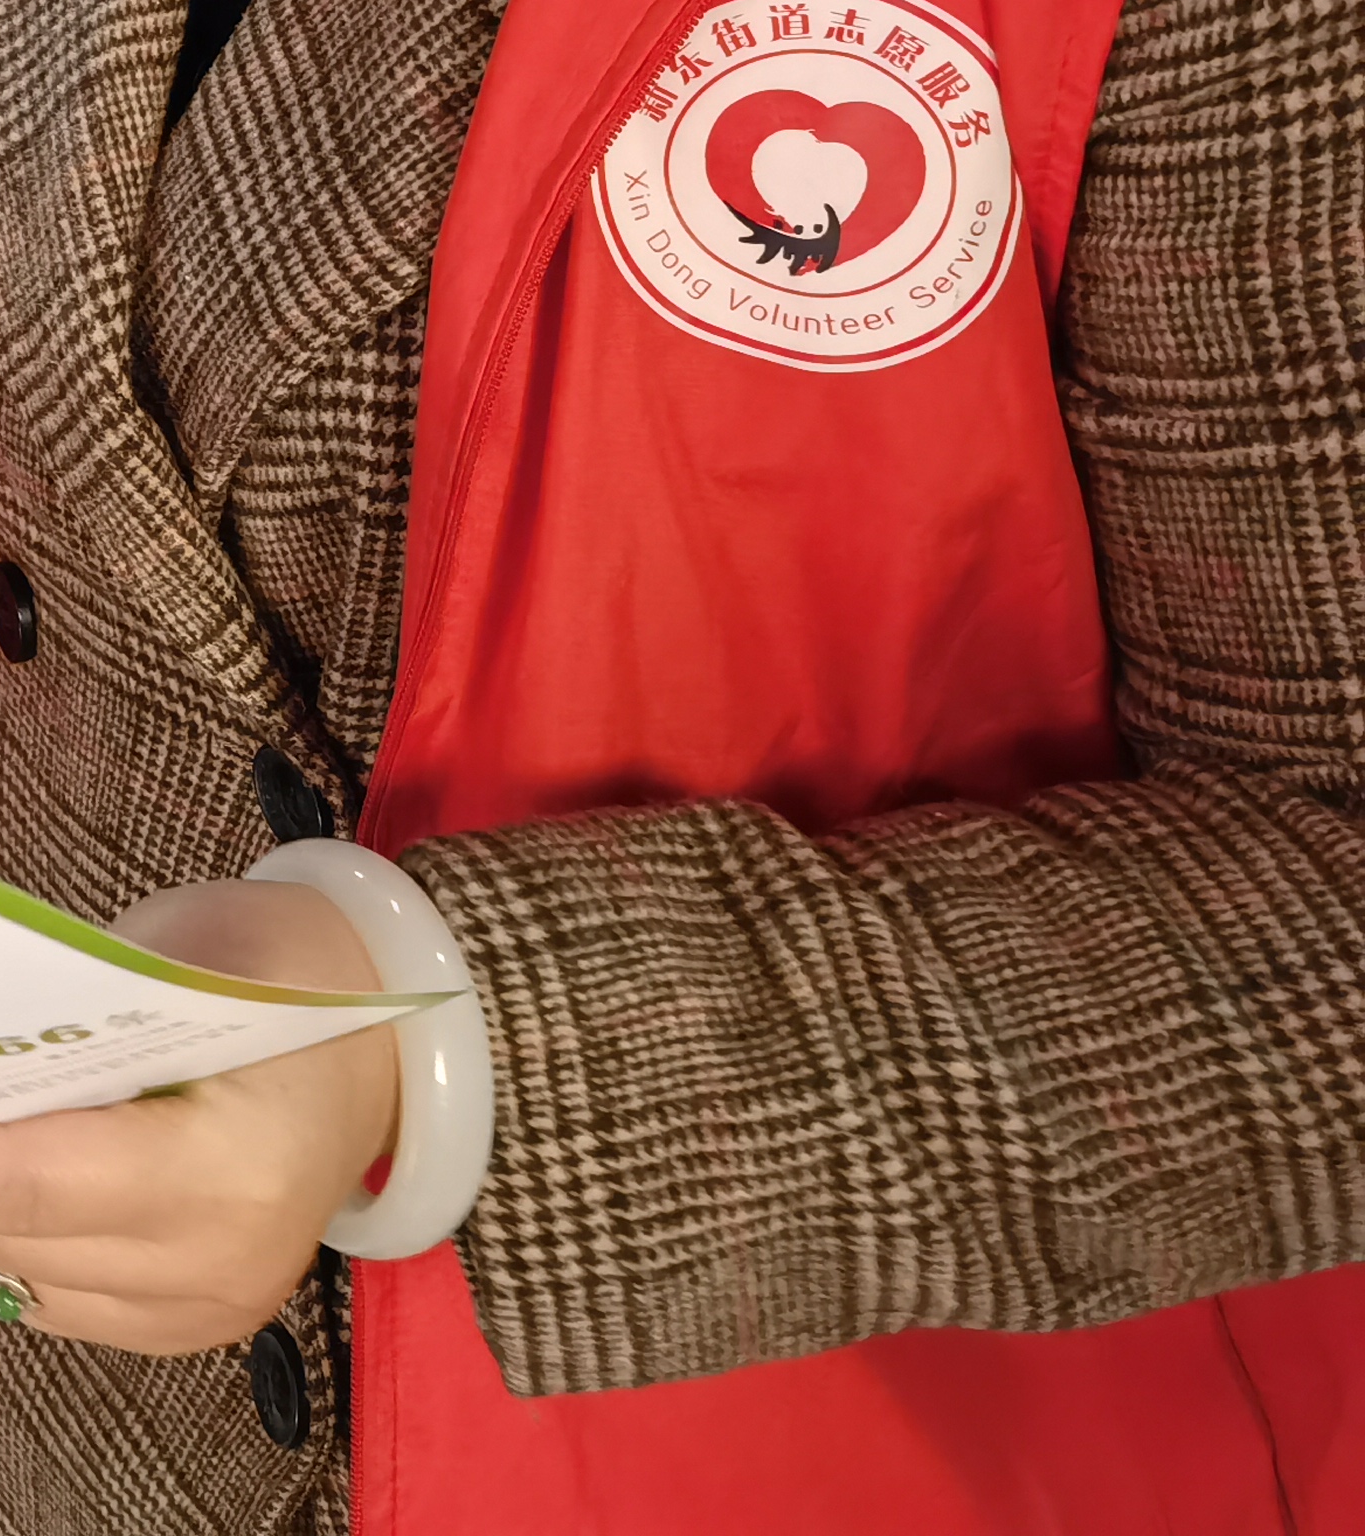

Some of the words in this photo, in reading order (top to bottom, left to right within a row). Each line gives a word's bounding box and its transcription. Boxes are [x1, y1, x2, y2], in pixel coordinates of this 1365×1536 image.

[623, 168, 651, 222] Xin
[647, 229, 714, 300] Dong
[727, 286, 899, 337] Volunteer
[908, 198, 993, 310] Service
